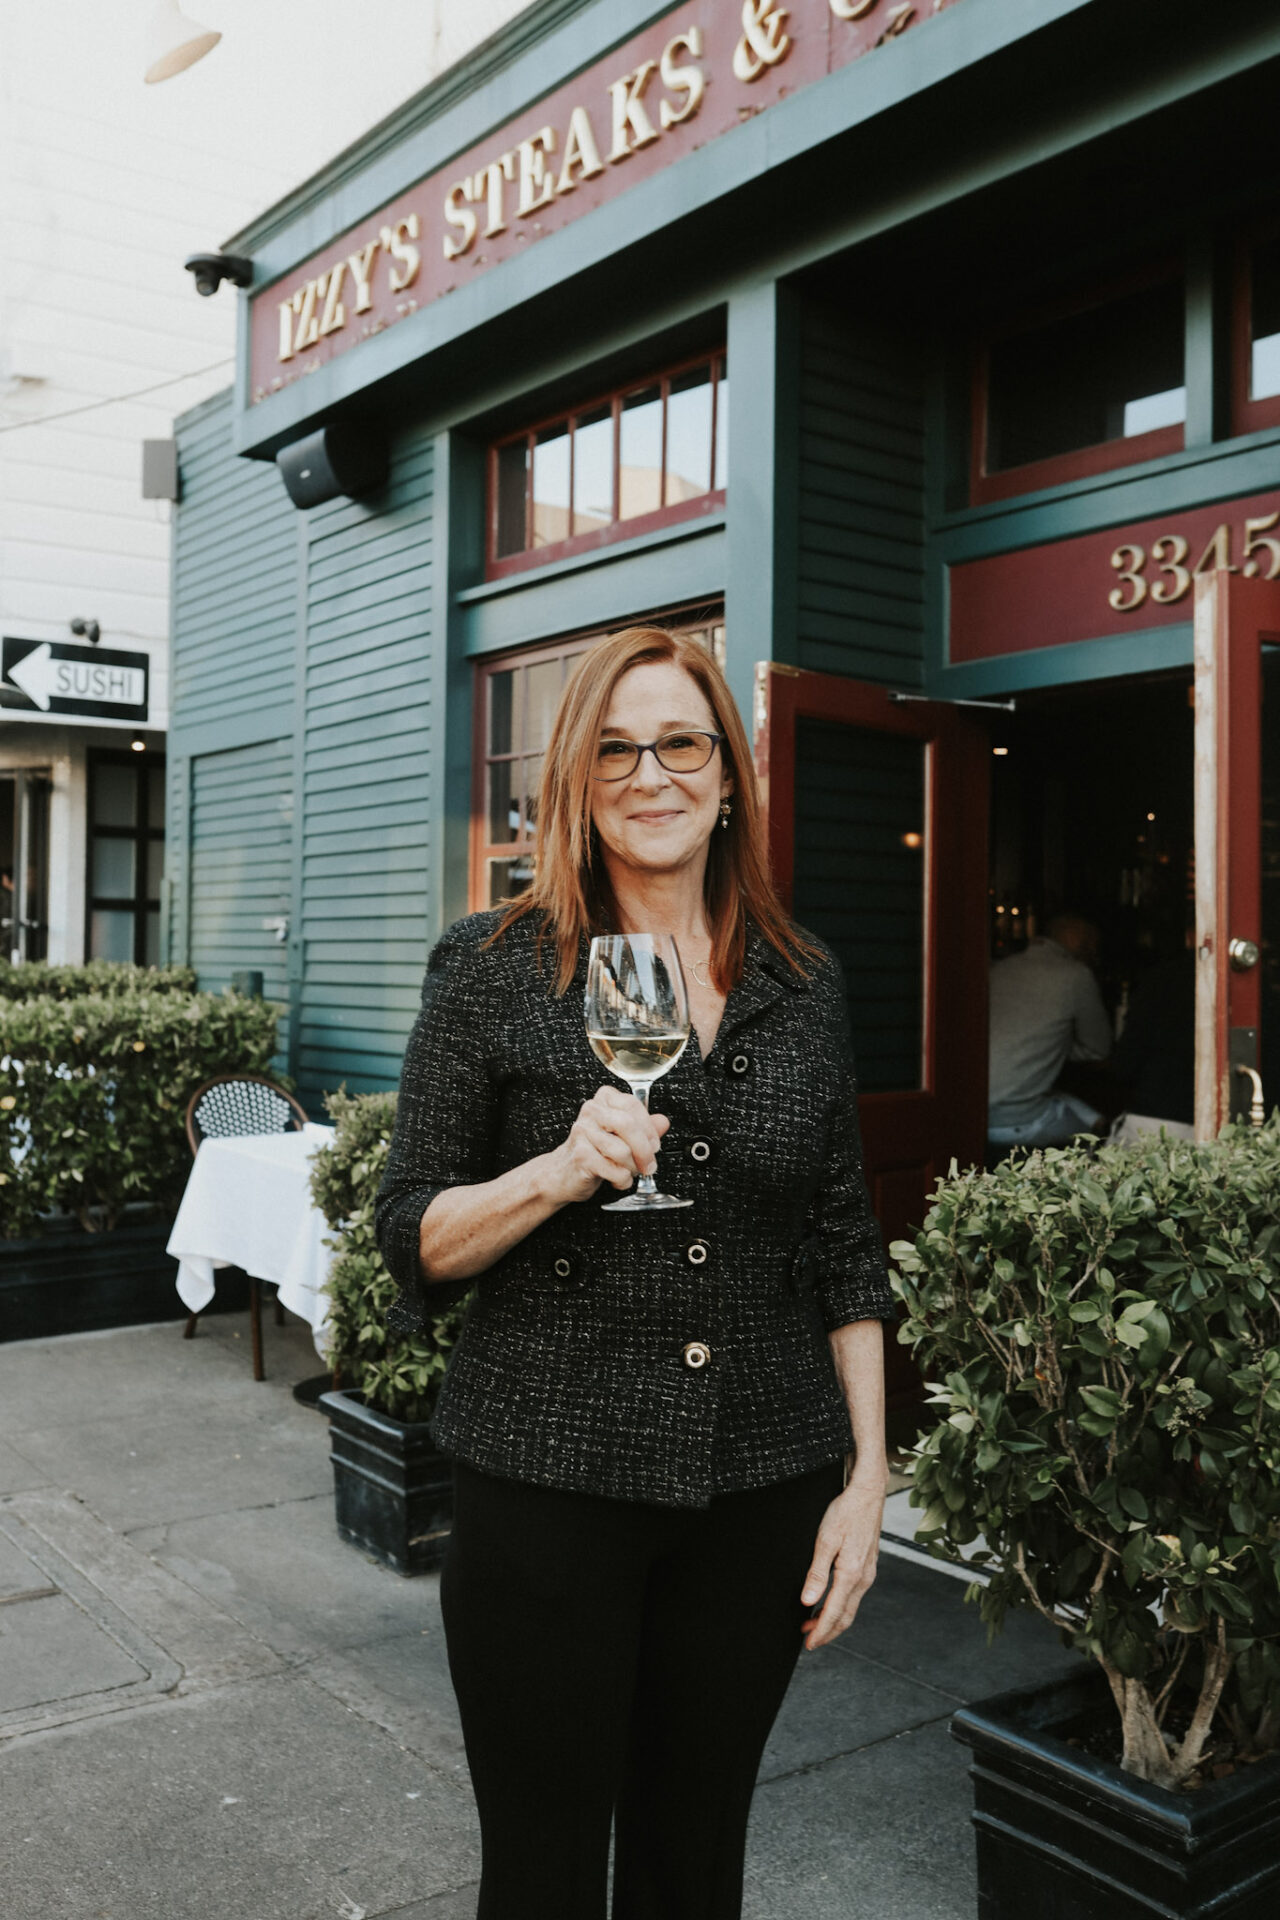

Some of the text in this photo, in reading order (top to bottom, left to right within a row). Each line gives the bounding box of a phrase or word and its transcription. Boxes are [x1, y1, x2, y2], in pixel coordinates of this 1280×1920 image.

[277, 0, 789, 362] IZZY'S STEAKS &
[57, 664, 133, 698] SUSHI
